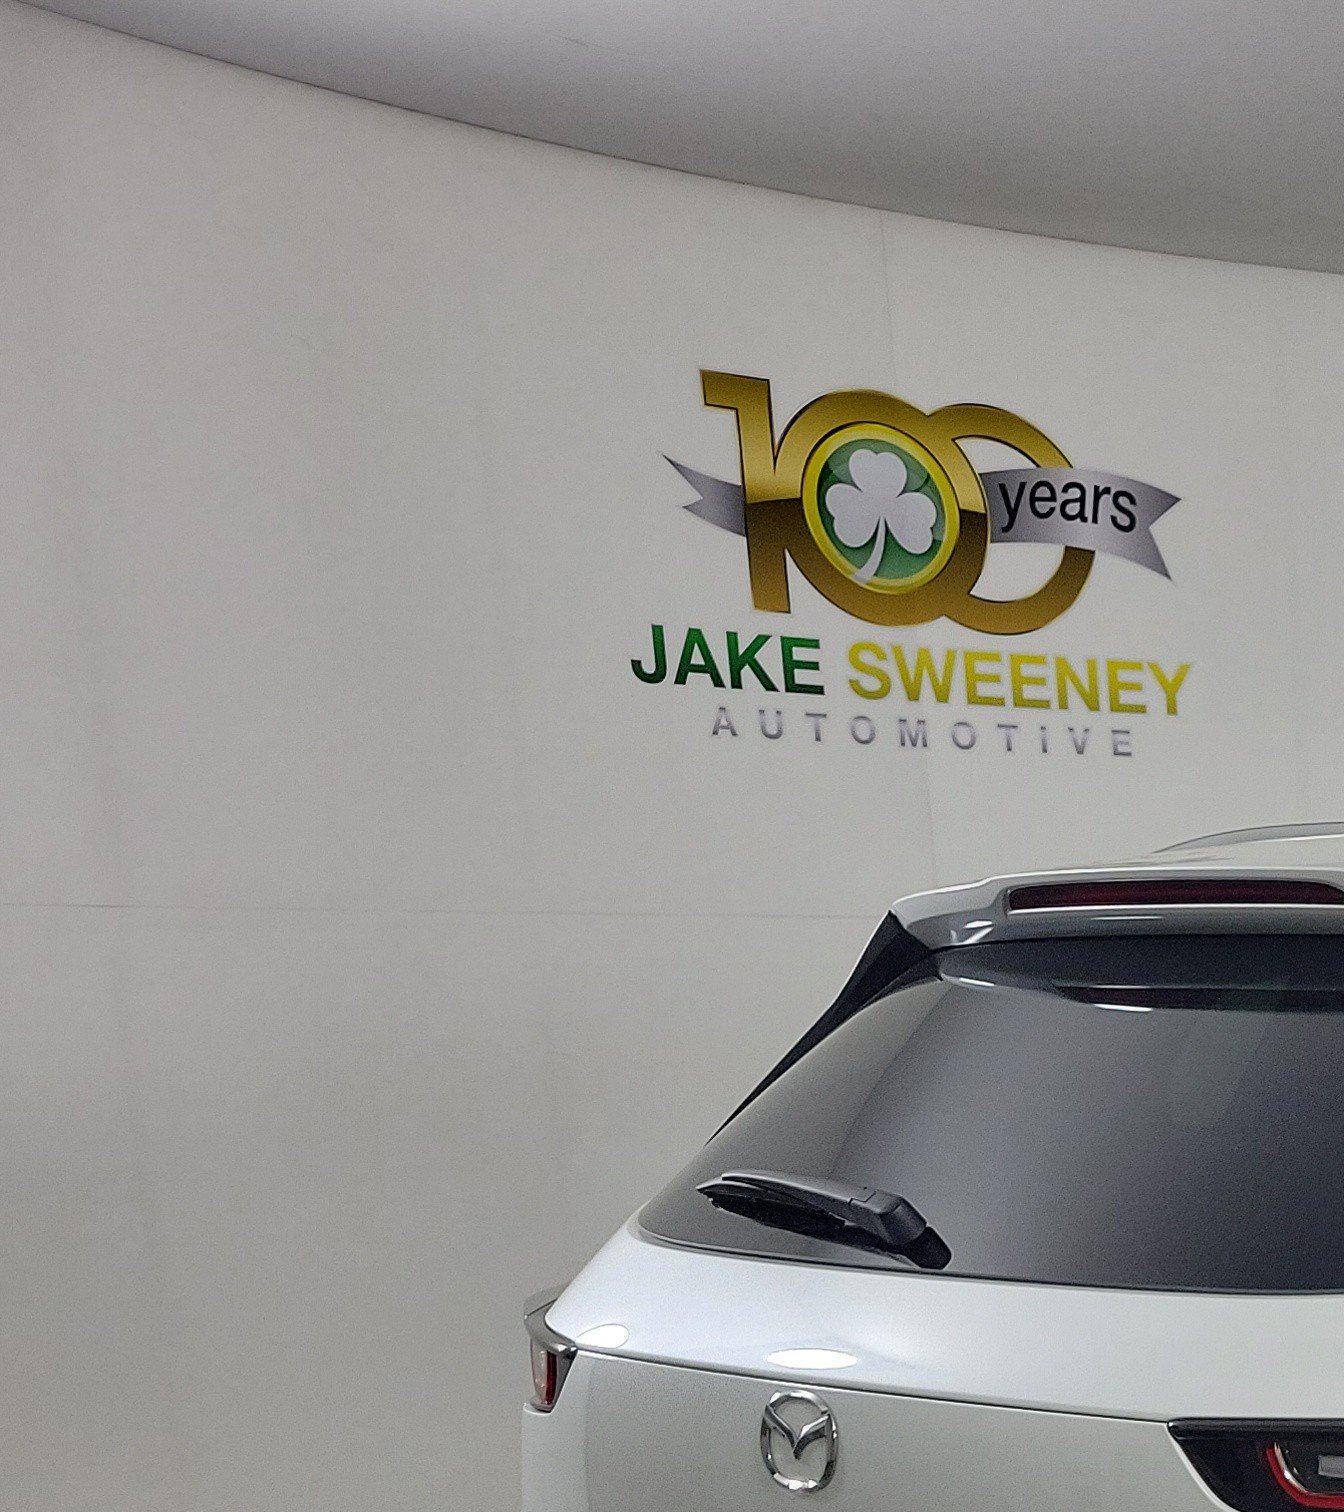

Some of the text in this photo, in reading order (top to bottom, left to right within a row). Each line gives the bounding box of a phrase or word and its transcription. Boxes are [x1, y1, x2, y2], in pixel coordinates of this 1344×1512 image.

[700, 369, 1138, 636] 100 years
[630, 623, 1191, 717] JAKE SWEENEY
[711, 706, 1134, 757] AUTOMOTIVE
